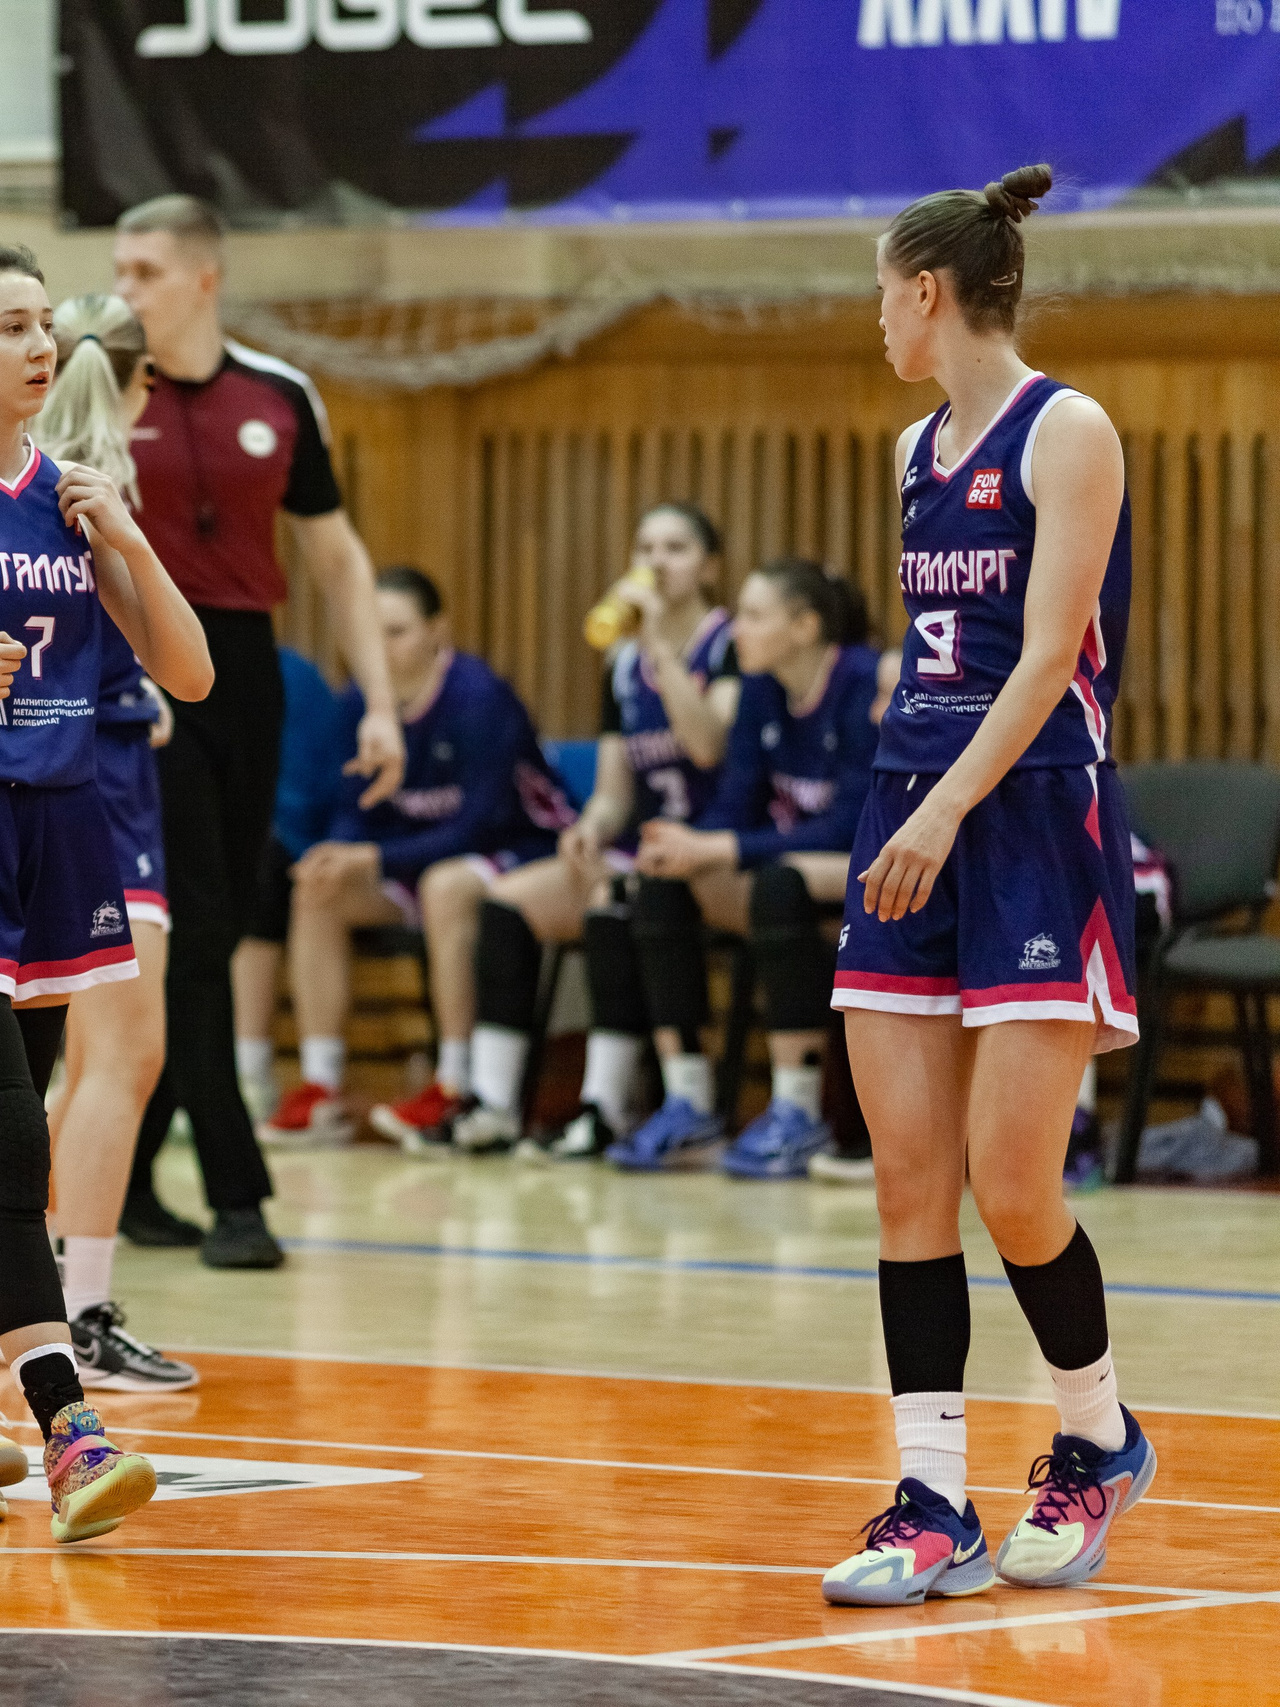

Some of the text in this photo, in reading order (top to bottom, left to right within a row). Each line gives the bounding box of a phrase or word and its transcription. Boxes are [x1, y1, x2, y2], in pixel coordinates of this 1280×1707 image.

[972, 473, 1001, 489] FON
[967, 489, 1000, 505] BET
[23, 615, 56, 681] 7
[914, 610, 962, 680] 9
[13, 697, 88, 707] МАГНИТОГОРСКИЙ
[12, 717, 60, 727] КОМБИНАТ
